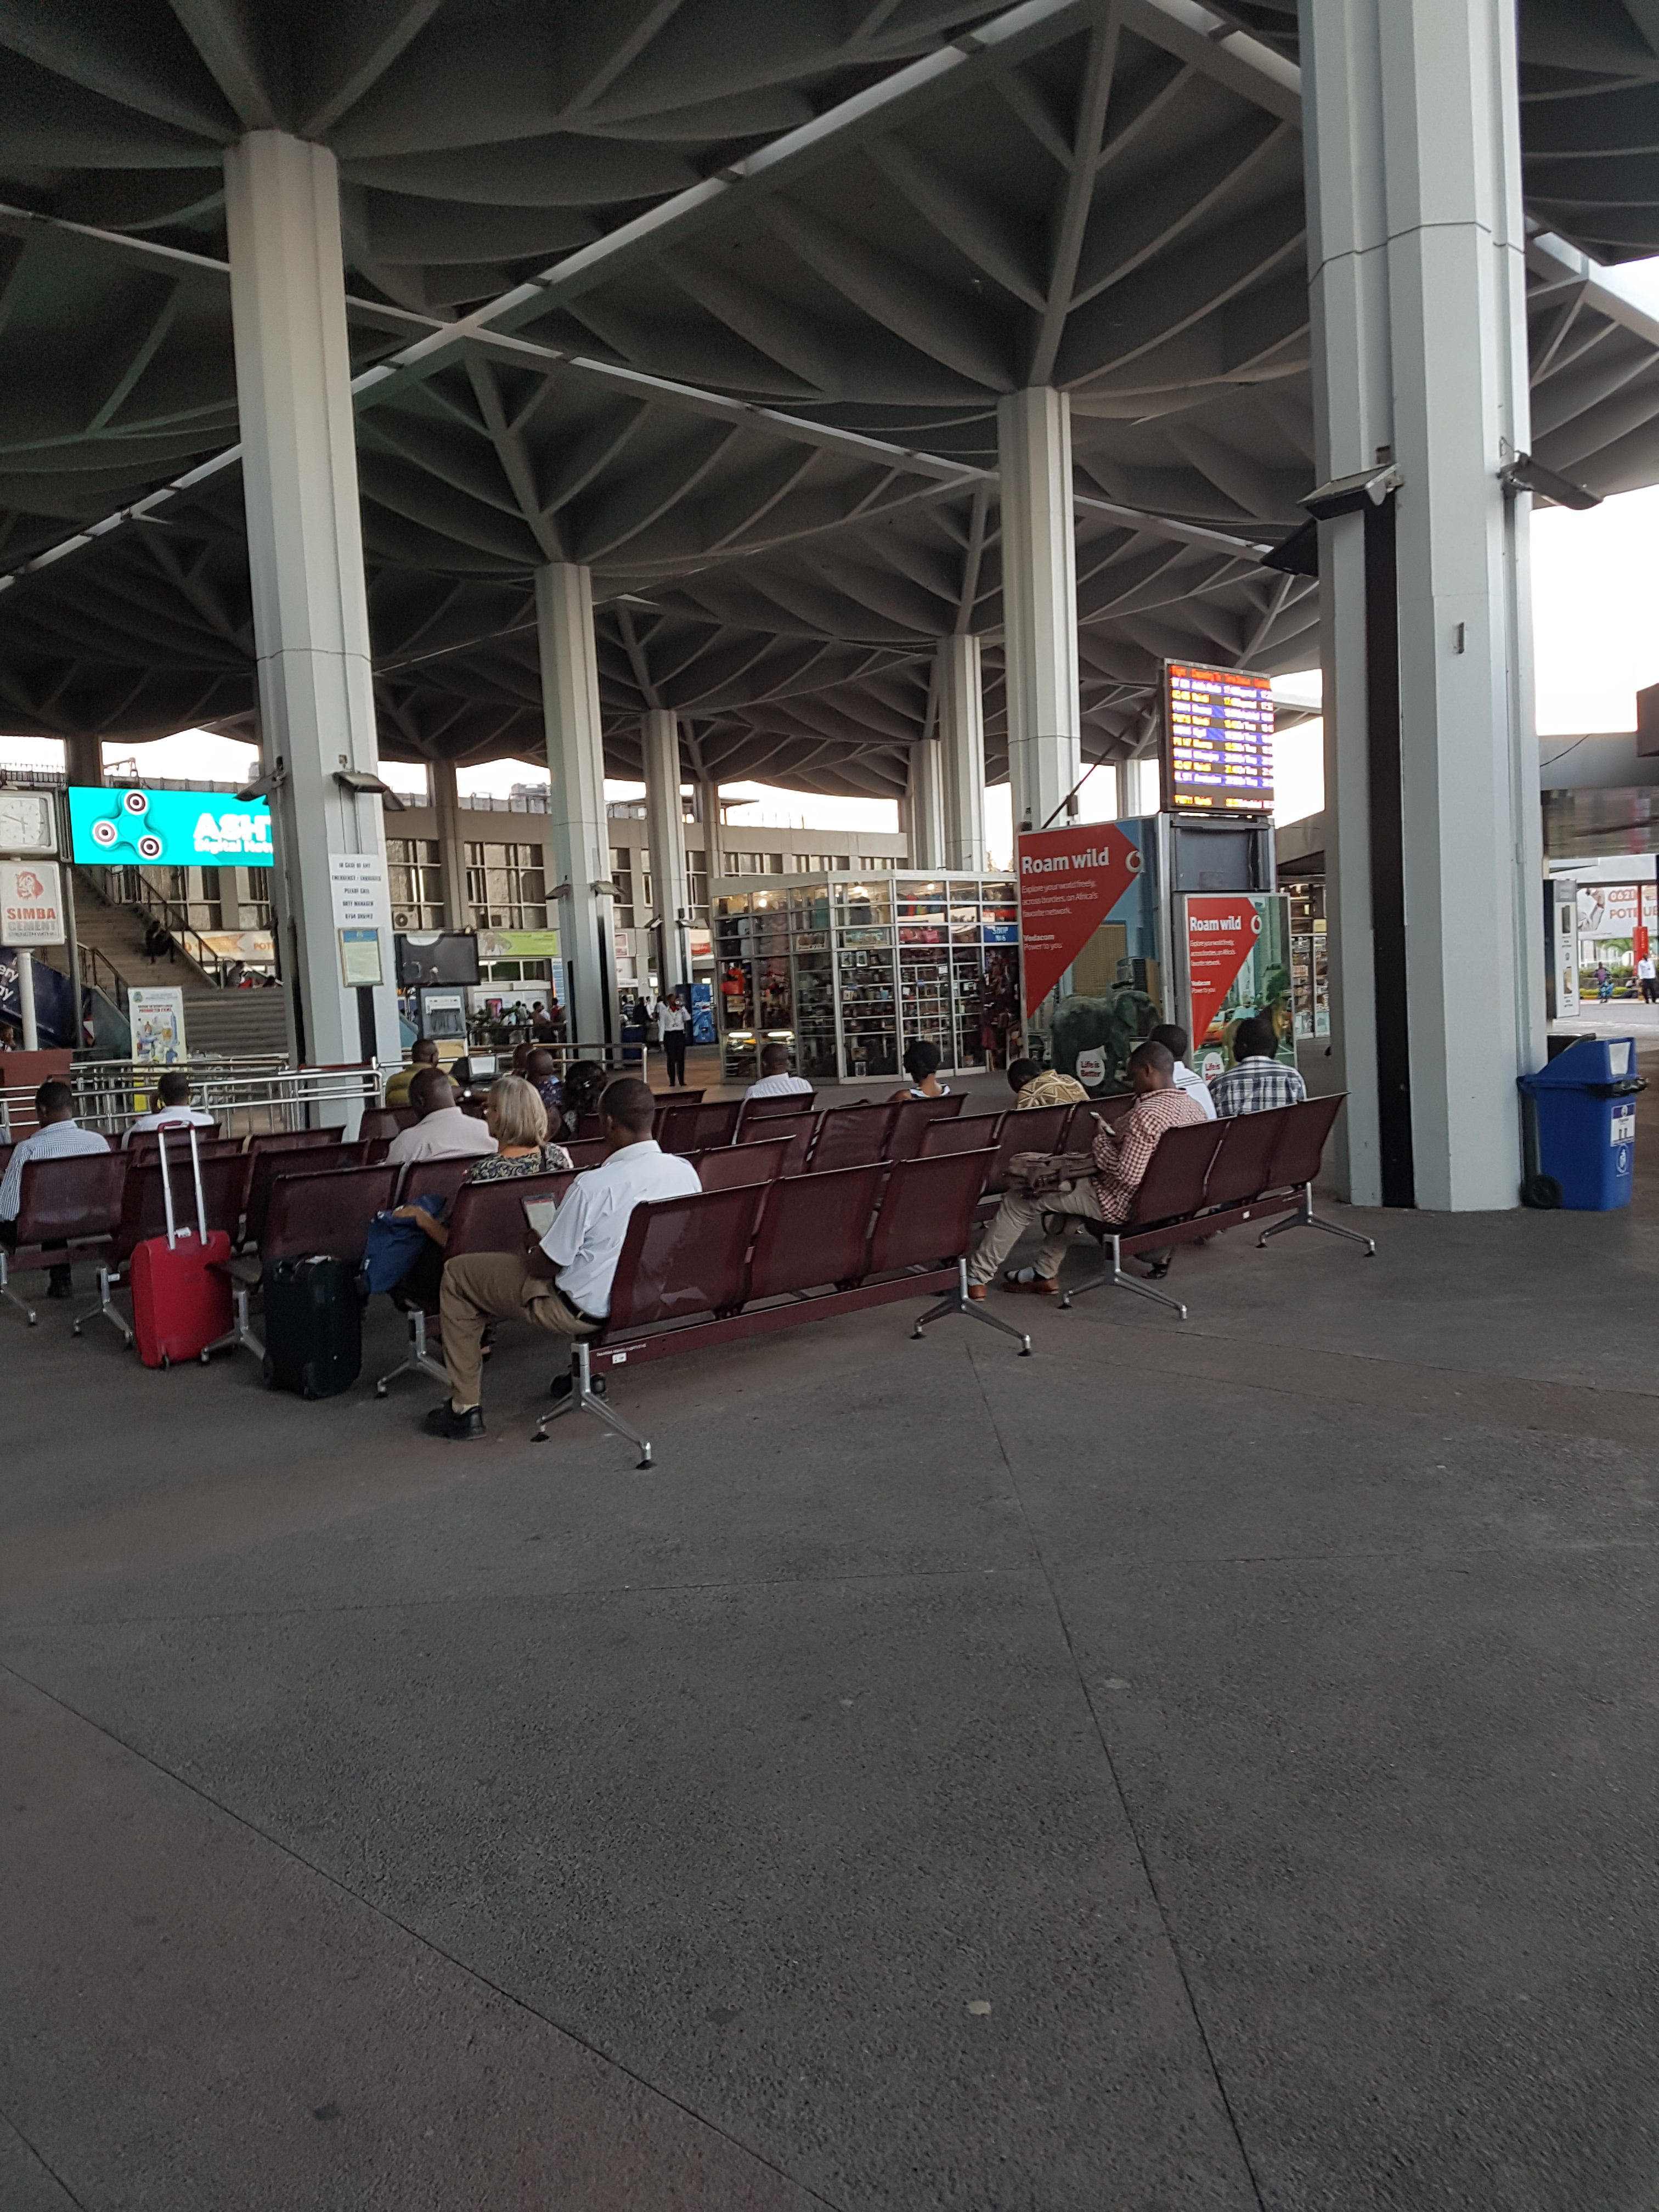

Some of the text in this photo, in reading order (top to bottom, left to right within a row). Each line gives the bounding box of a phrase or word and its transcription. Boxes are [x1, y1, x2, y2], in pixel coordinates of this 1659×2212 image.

[194, 839, 242, 855] Digital
[1022, 847, 1110, 874] Roam wild
[7, 908, 56, 919] SIMBA
[8, 921, 55, 931] CEMENT
[1190, 916, 1242, 931] Roam wild
